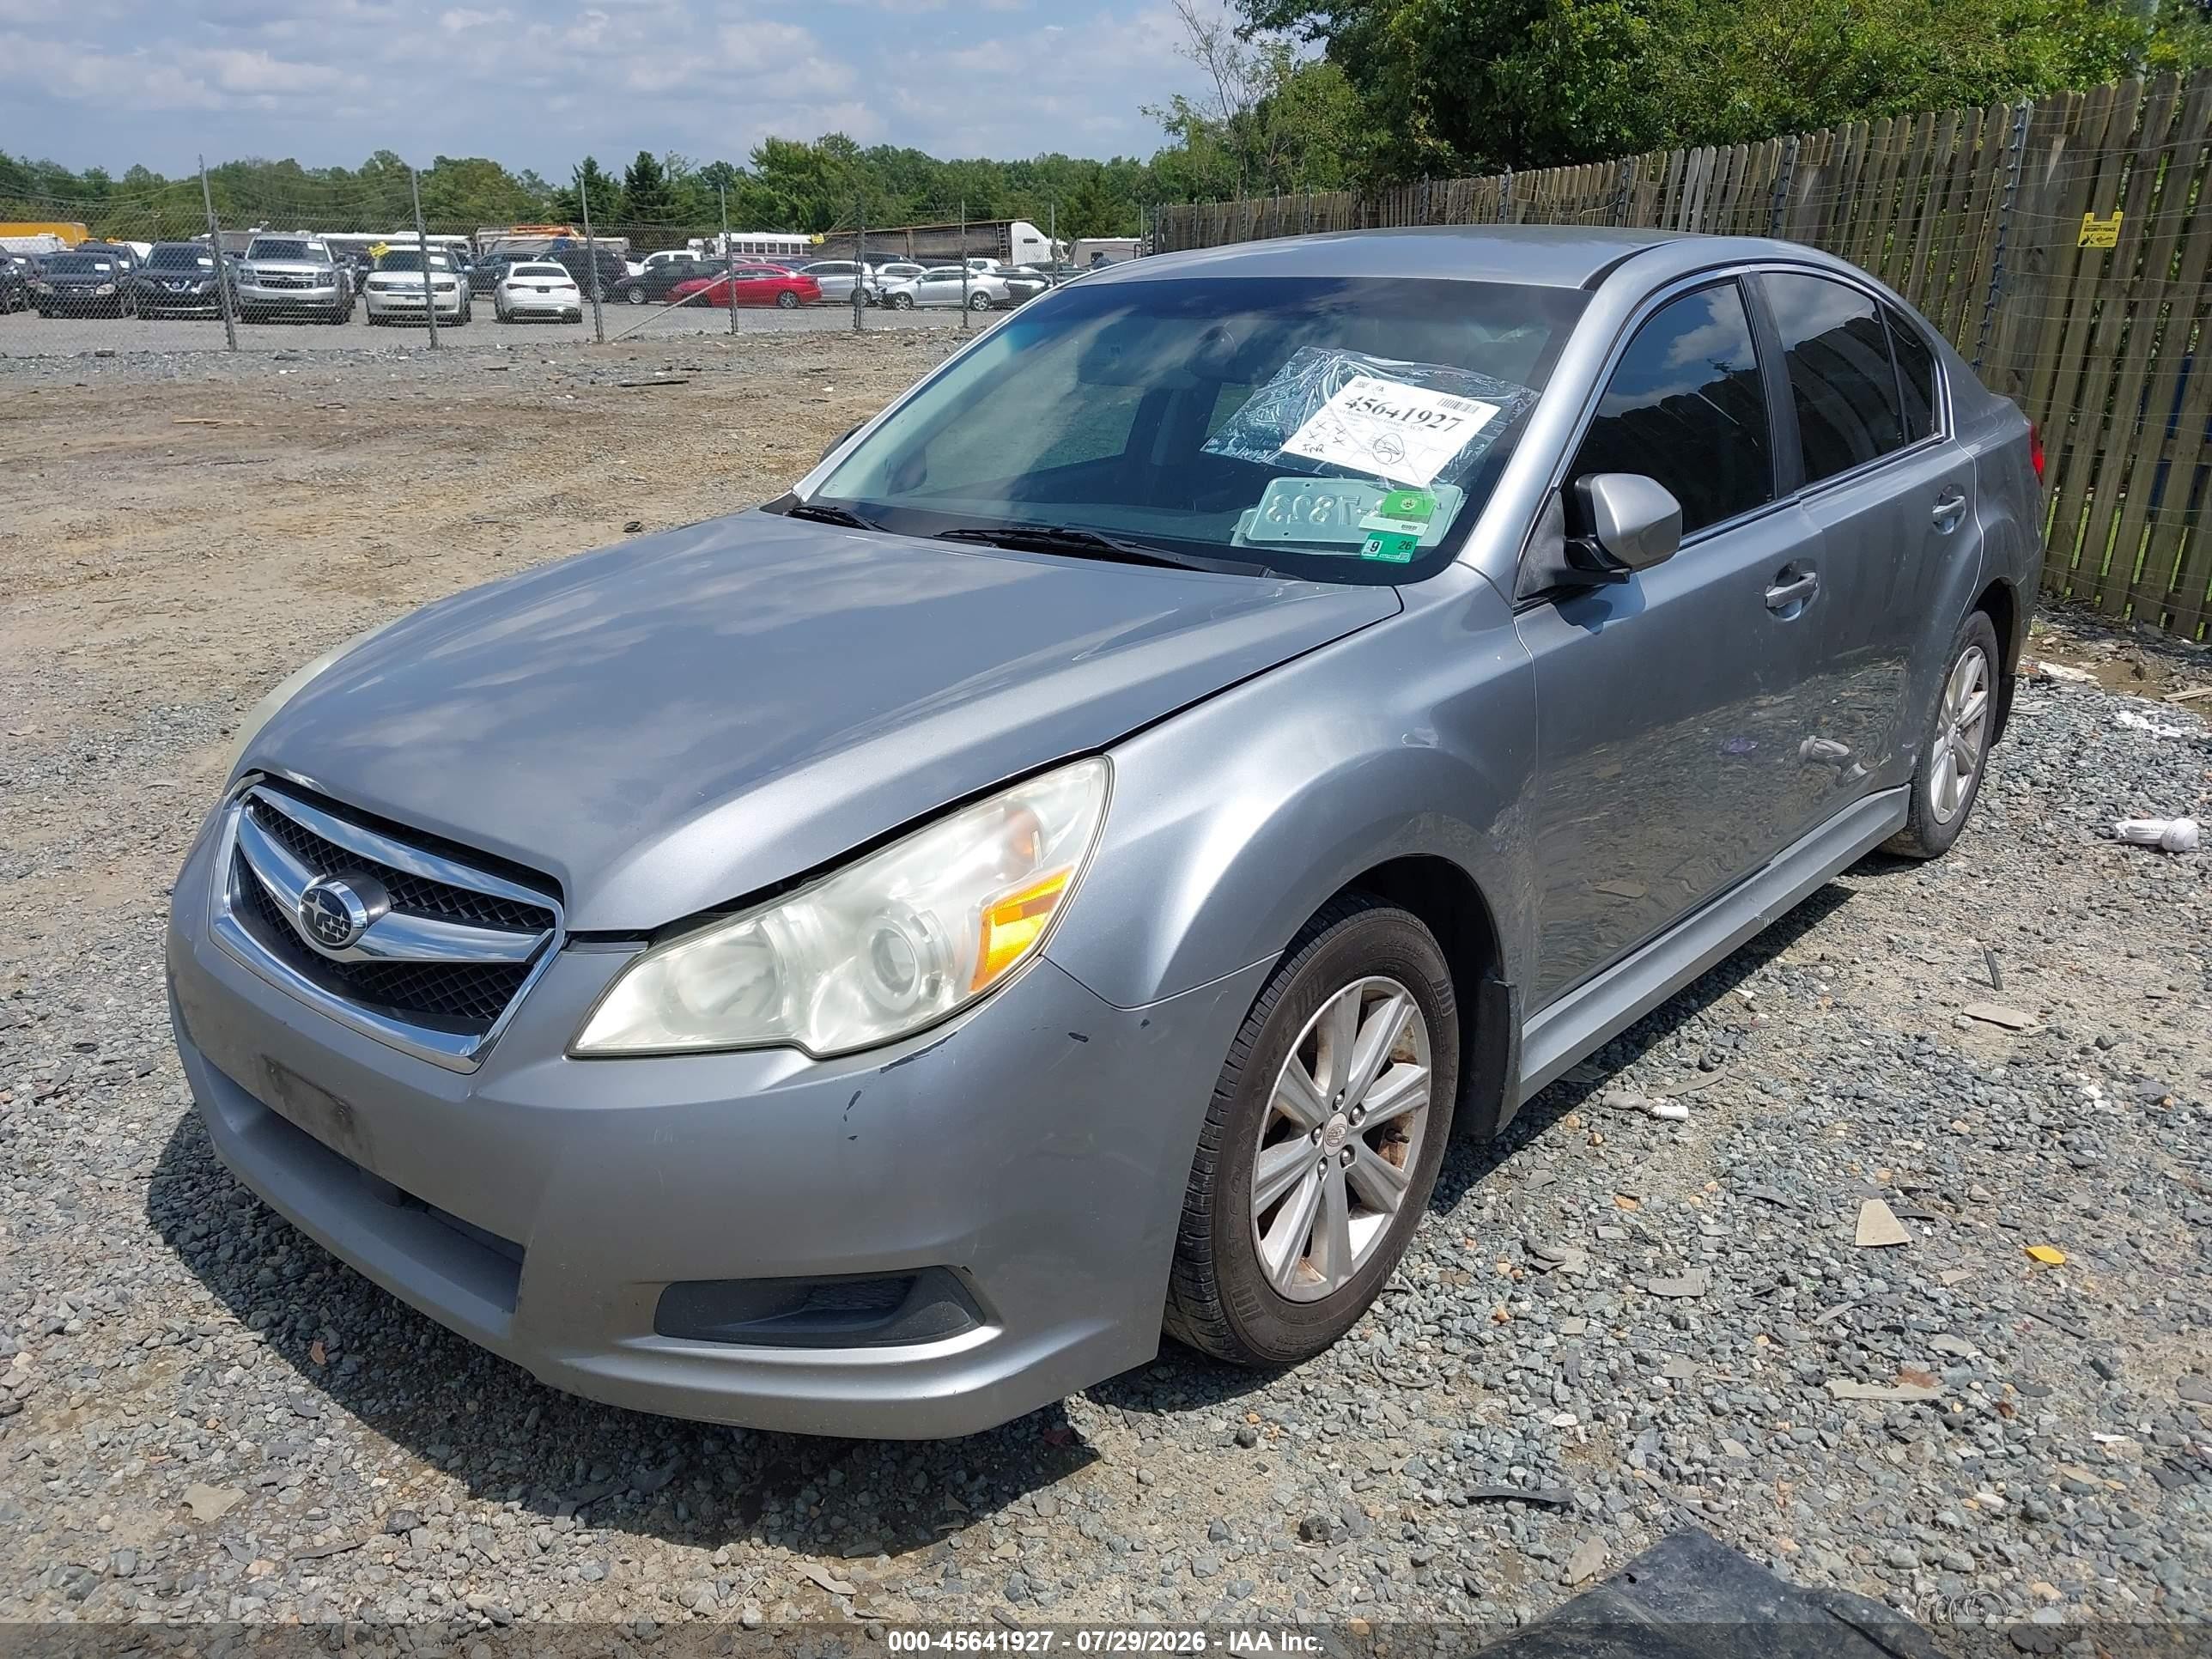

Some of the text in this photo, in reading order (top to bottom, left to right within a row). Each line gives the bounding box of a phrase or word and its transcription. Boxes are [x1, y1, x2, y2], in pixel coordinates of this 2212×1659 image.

[1344, 396, 1465, 433] 45641927
[1370, 541, 1381, 552] 9
[1397, 540, 1413, 550] 26
